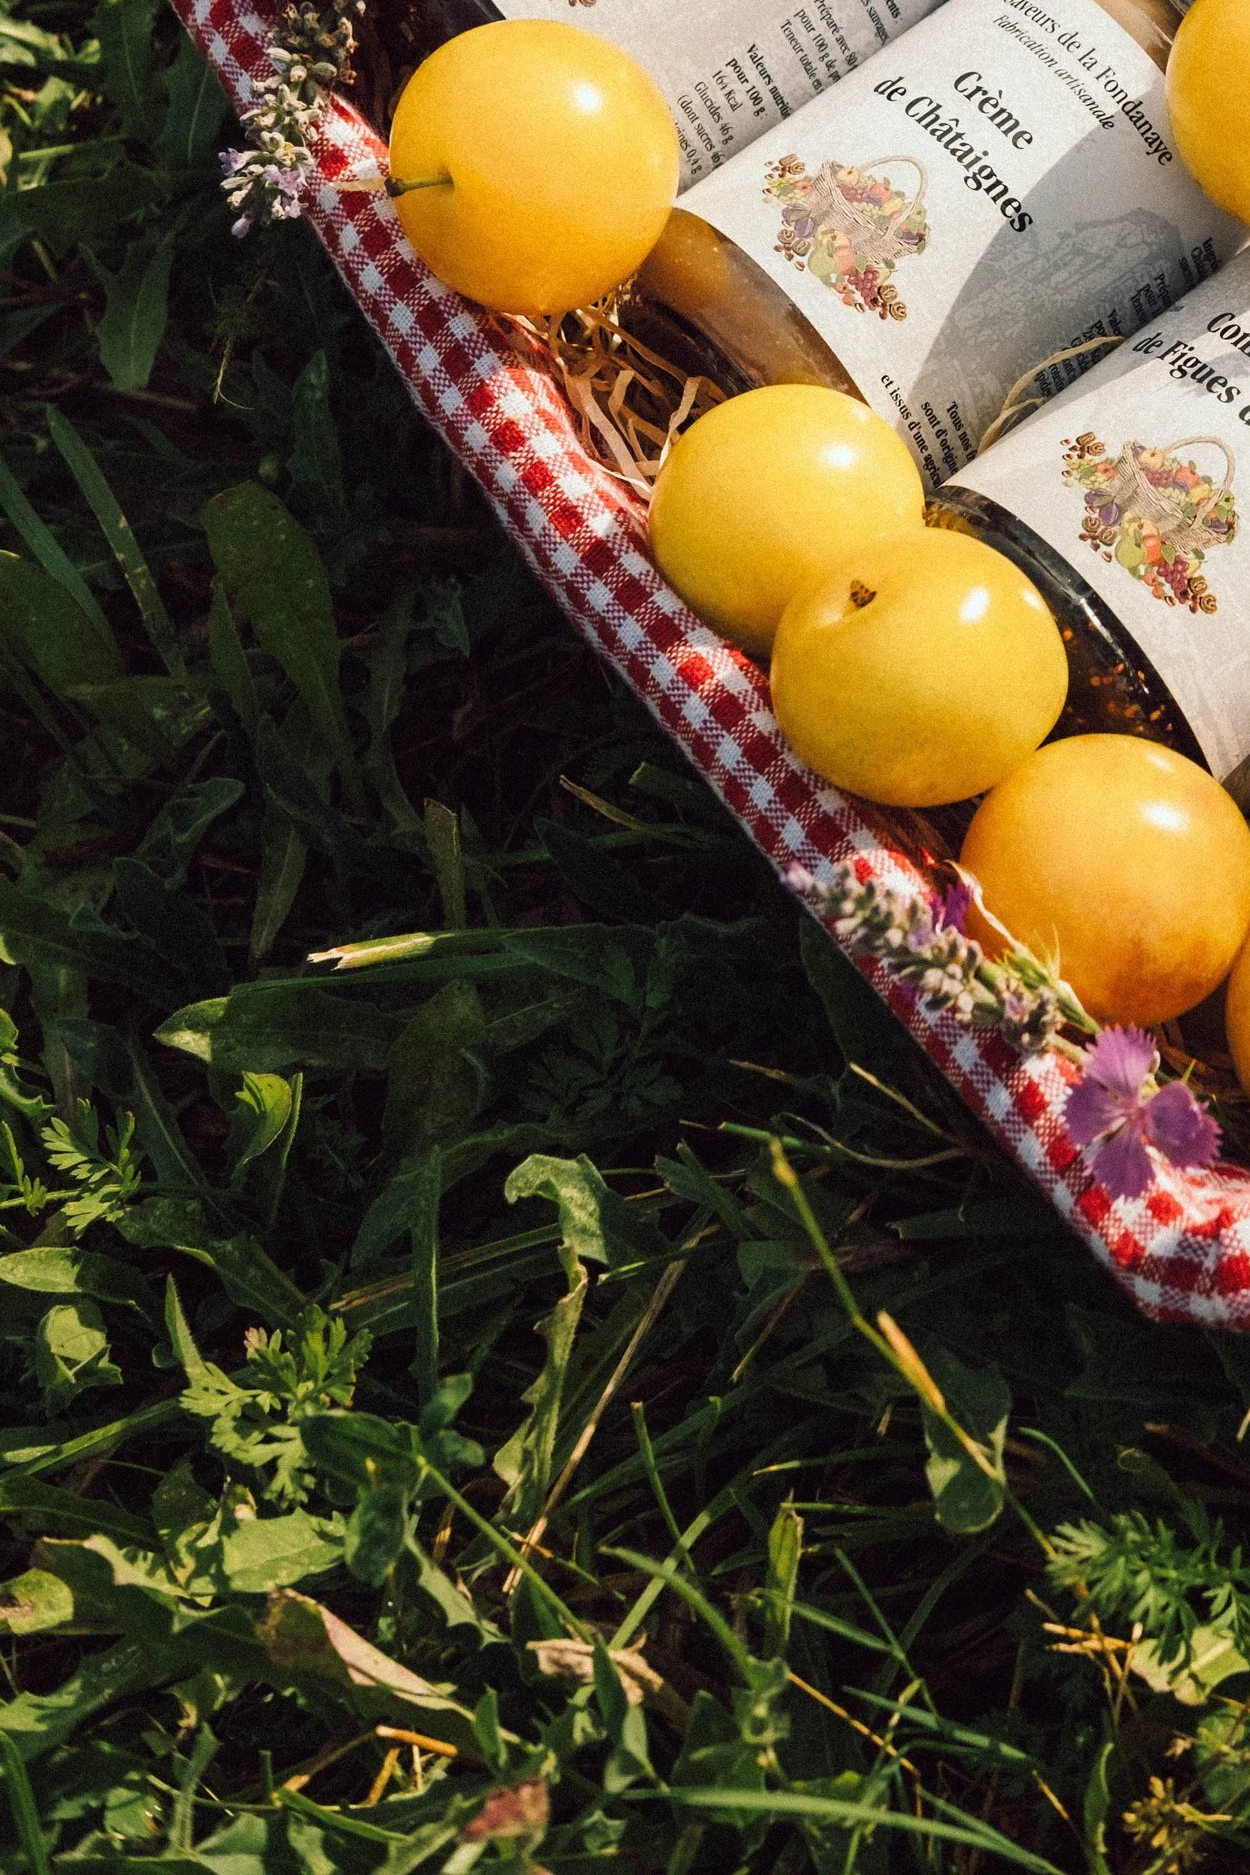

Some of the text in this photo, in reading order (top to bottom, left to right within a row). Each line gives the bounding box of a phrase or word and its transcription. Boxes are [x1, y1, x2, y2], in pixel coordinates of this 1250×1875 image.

[780, 19, 804, 54] Teneur
[799, 54, 818, 79] totale
[793, 9, 816, 33] pour
[812, 33, 828, 53] 100
[725, 58, 749, 84] pour
[745, 85, 764, 107] 100
[746, 43, 774, 86] Valeurs
[993, 14, 1115, 131] Fabrication artisanale
[677, 94, 700, 124] (dont
[694, 123, 716, 152] sucres
[694, 81, 723, 124] Glucides
[724, 89, 744, 112] Kcal
[953, 71, 1034, 150] Crème
[1057, 31, 1081, 53] de
[1077, 48, 1098, 71] la
[1095, 66, 1172, 166] Fondanaye
[873, 75, 1034, 233] de Châtaignes
[1132, 332, 1164, 355] de
[1156, 339, 1241, 404] Figues
[881, 374, 894, 388] et
[889, 387, 912, 420] issus
[907, 421, 929, 454] d'une
[921, 401, 941, 429] sont
[946, 401, 964, 432] Tous
